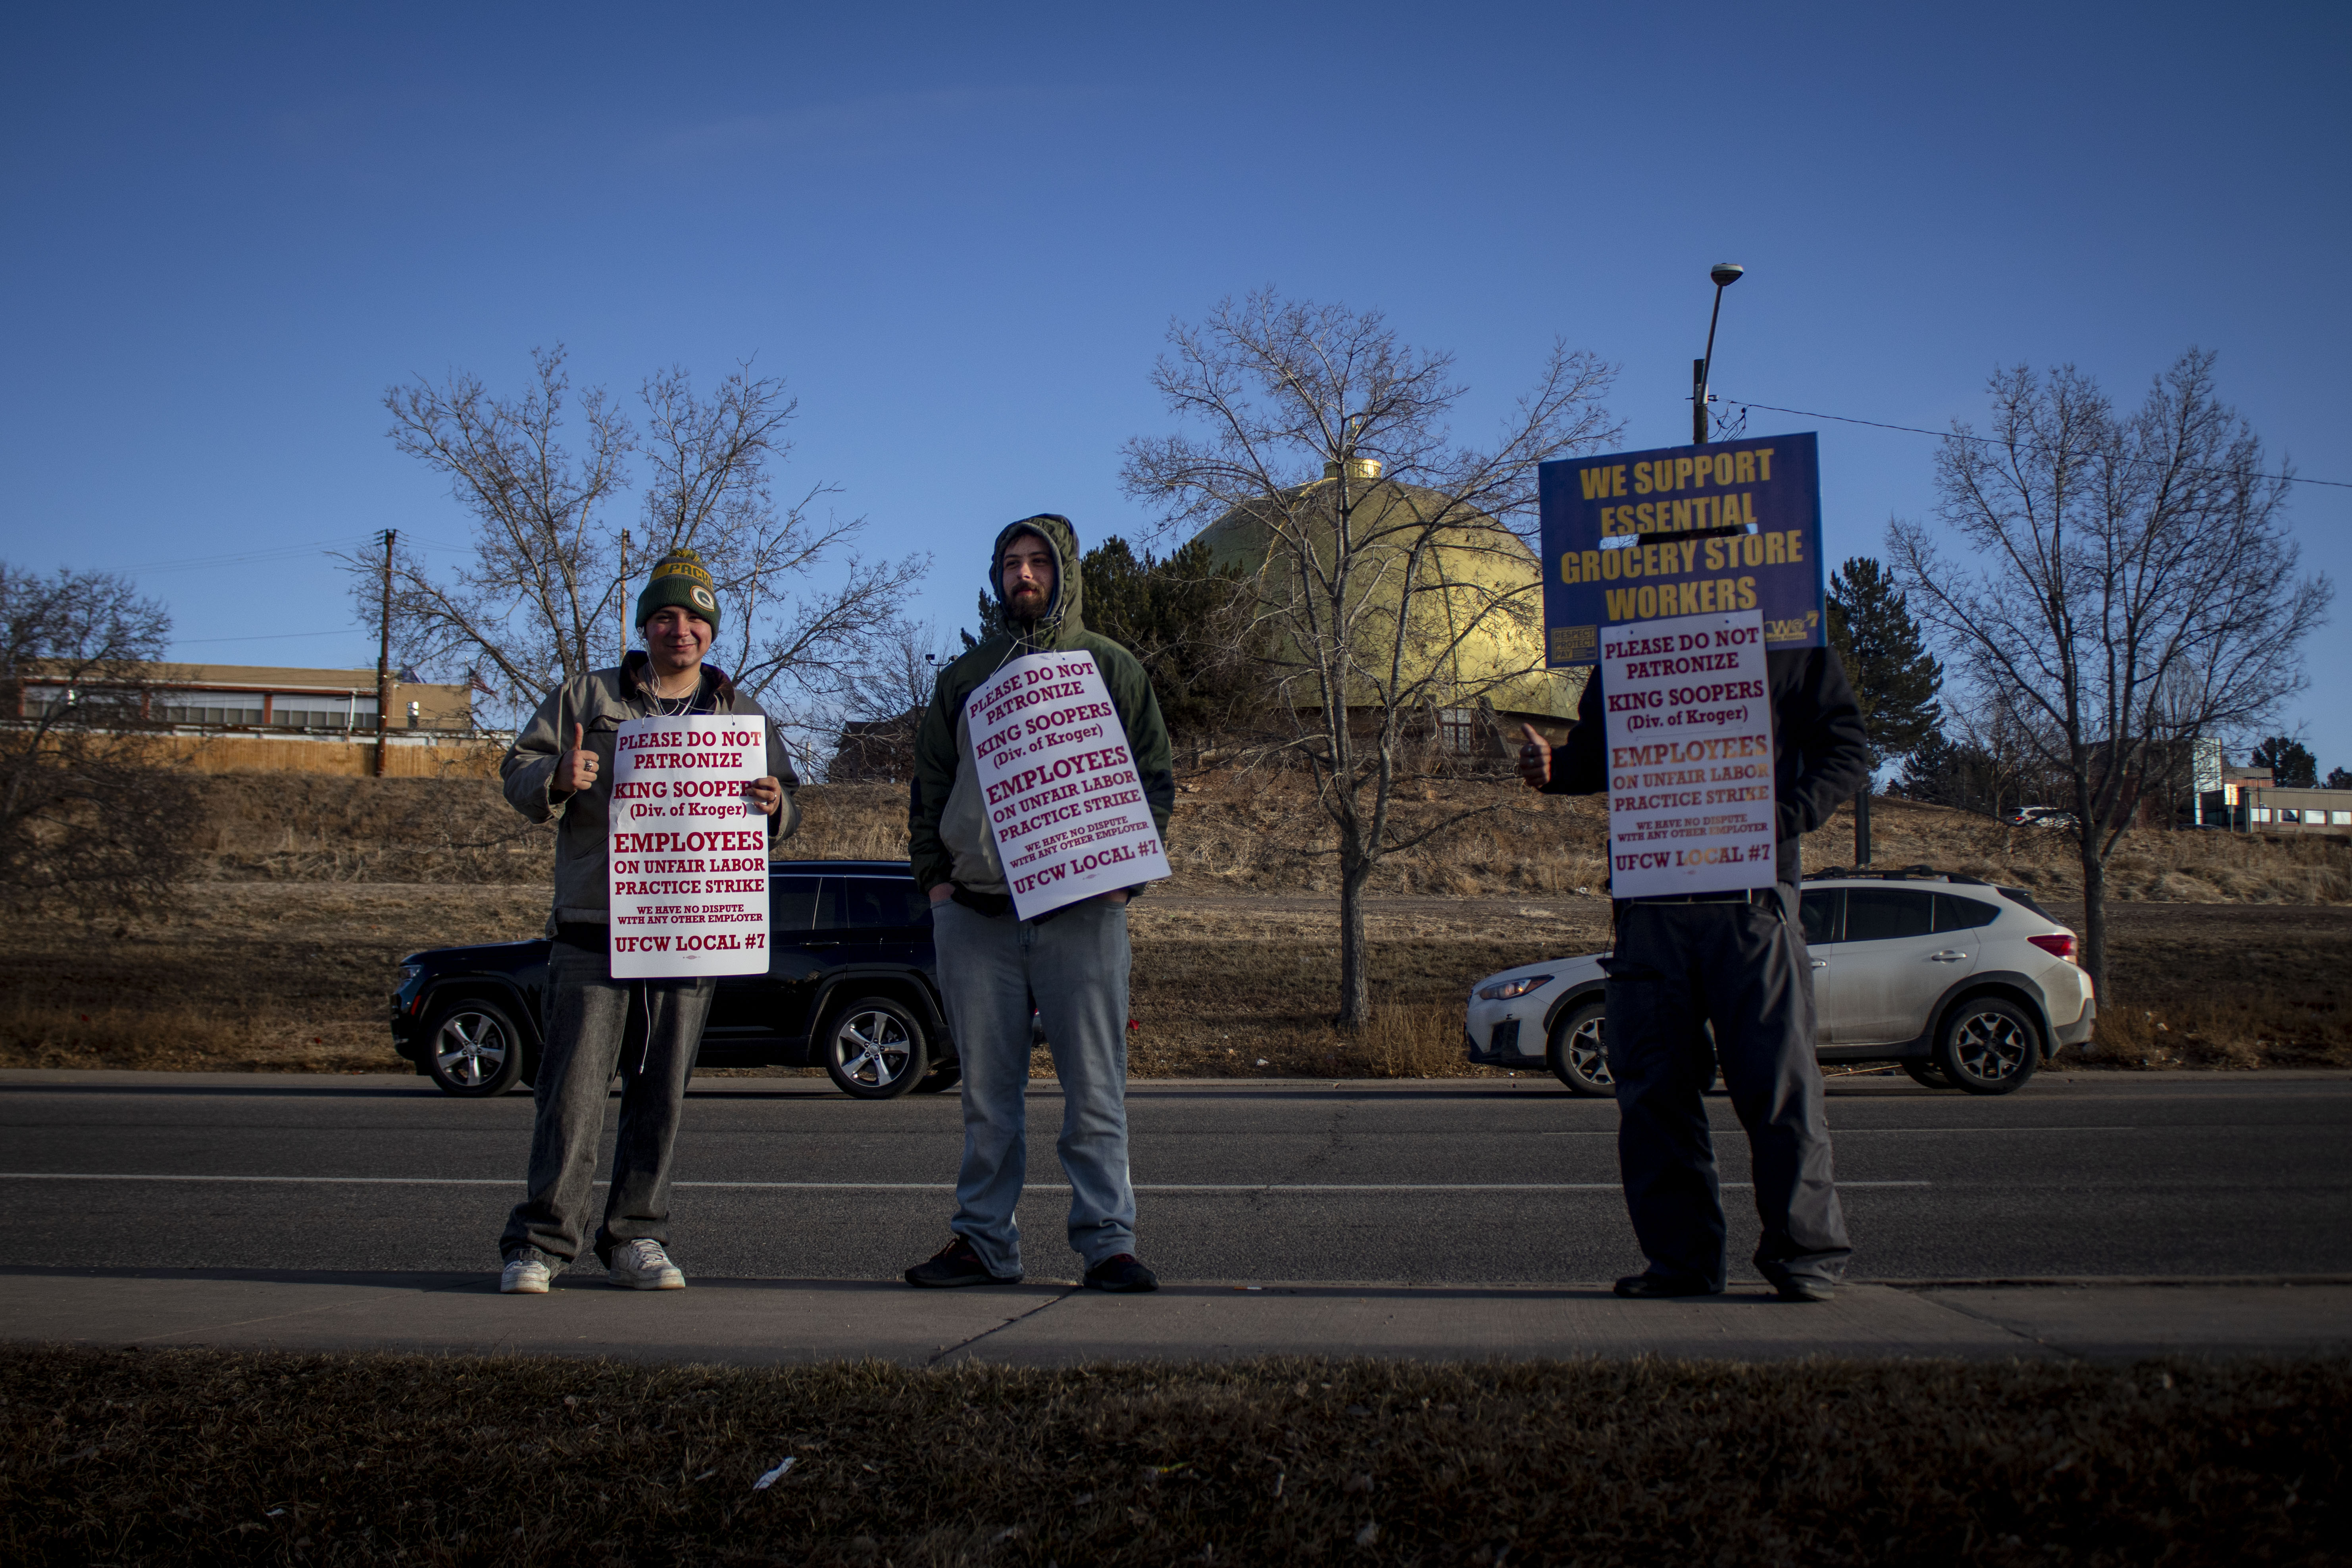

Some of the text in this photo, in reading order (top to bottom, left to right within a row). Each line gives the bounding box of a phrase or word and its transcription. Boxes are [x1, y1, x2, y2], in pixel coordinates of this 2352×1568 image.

[1580, 448, 1774, 500] WE SUPPORT
[1601, 493, 1758, 538] ESSENTIAL
[1561, 529, 1803, 584] GROCERY STORE
[1606, 576, 1757, 621] WORKERS
[1555, 629, 1594, 639] RESPECT
[1556, 639, 1593, 648] PROTECT
[1605, 636, 1675, 660] PLEASE
[1679, 633, 1710, 651] DO
[1715, 627, 1759, 647] NOT
[1627, 652, 1739, 679] PATRONIZE
[969, 662, 1094, 719] PLEASE DO NOT
[986, 681, 1085, 725] PATRONIZE
[1608, 680, 1764, 712] KING SOOPERS
[976, 702, 1113, 760] KING SOOPERS
[1627, 705, 1748, 733] (Div. of Kroger)
[619, 731, 761, 751] PLEASE DO NOT
[993, 723, 1103, 770] (Div. of Kroger)
[1612, 735, 1768, 769] EMPLOYEES
[634, 753, 742, 769] PATRONIZE
[986, 745, 1129, 806] EMPLOYEES
[1613, 764, 1770, 790] ON UNFAIR LABOR
[614, 781, 752, 799] KING SOOPER
[994, 770, 1137, 823] ON UNFAIR LABOR
[1614, 785, 1769, 812] PRACTICE STRIKE
[630, 802, 747, 820] (Div. of Kroger)
[999, 789, 1141, 843] PRACTICE STRIKE
[1637, 814, 1747, 831] WE HAVE NO DISPUTE
[614, 831, 763, 853] EMPLOYEES
[1010, 821, 1149, 869] WITH ANY OTHER EMPLOYER
[1025, 816, 1128, 852] WE HAVE NO DISPUTE
[1617, 823, 1768, 842] WITH ANY OTHER EMPLOYER
[614, 858, 765, 874] ON UNFAIR LABOR
[1013, 839, 1158, 895] UFCW LOCAL #7
[1615, 844, 1771, 871] UFCW LOCAL #7
[615, 879, 764, 895] PRACTICE STRIKE
[617, 916, 645, 924] WITH
[671, 915, 706, 923] OTHER
[708, 914, 763, 923] EMPLOYER
[702, 904, 744, 913] DISPUTE
[615, 933, 765, 952] UFCW LOCAL #7
